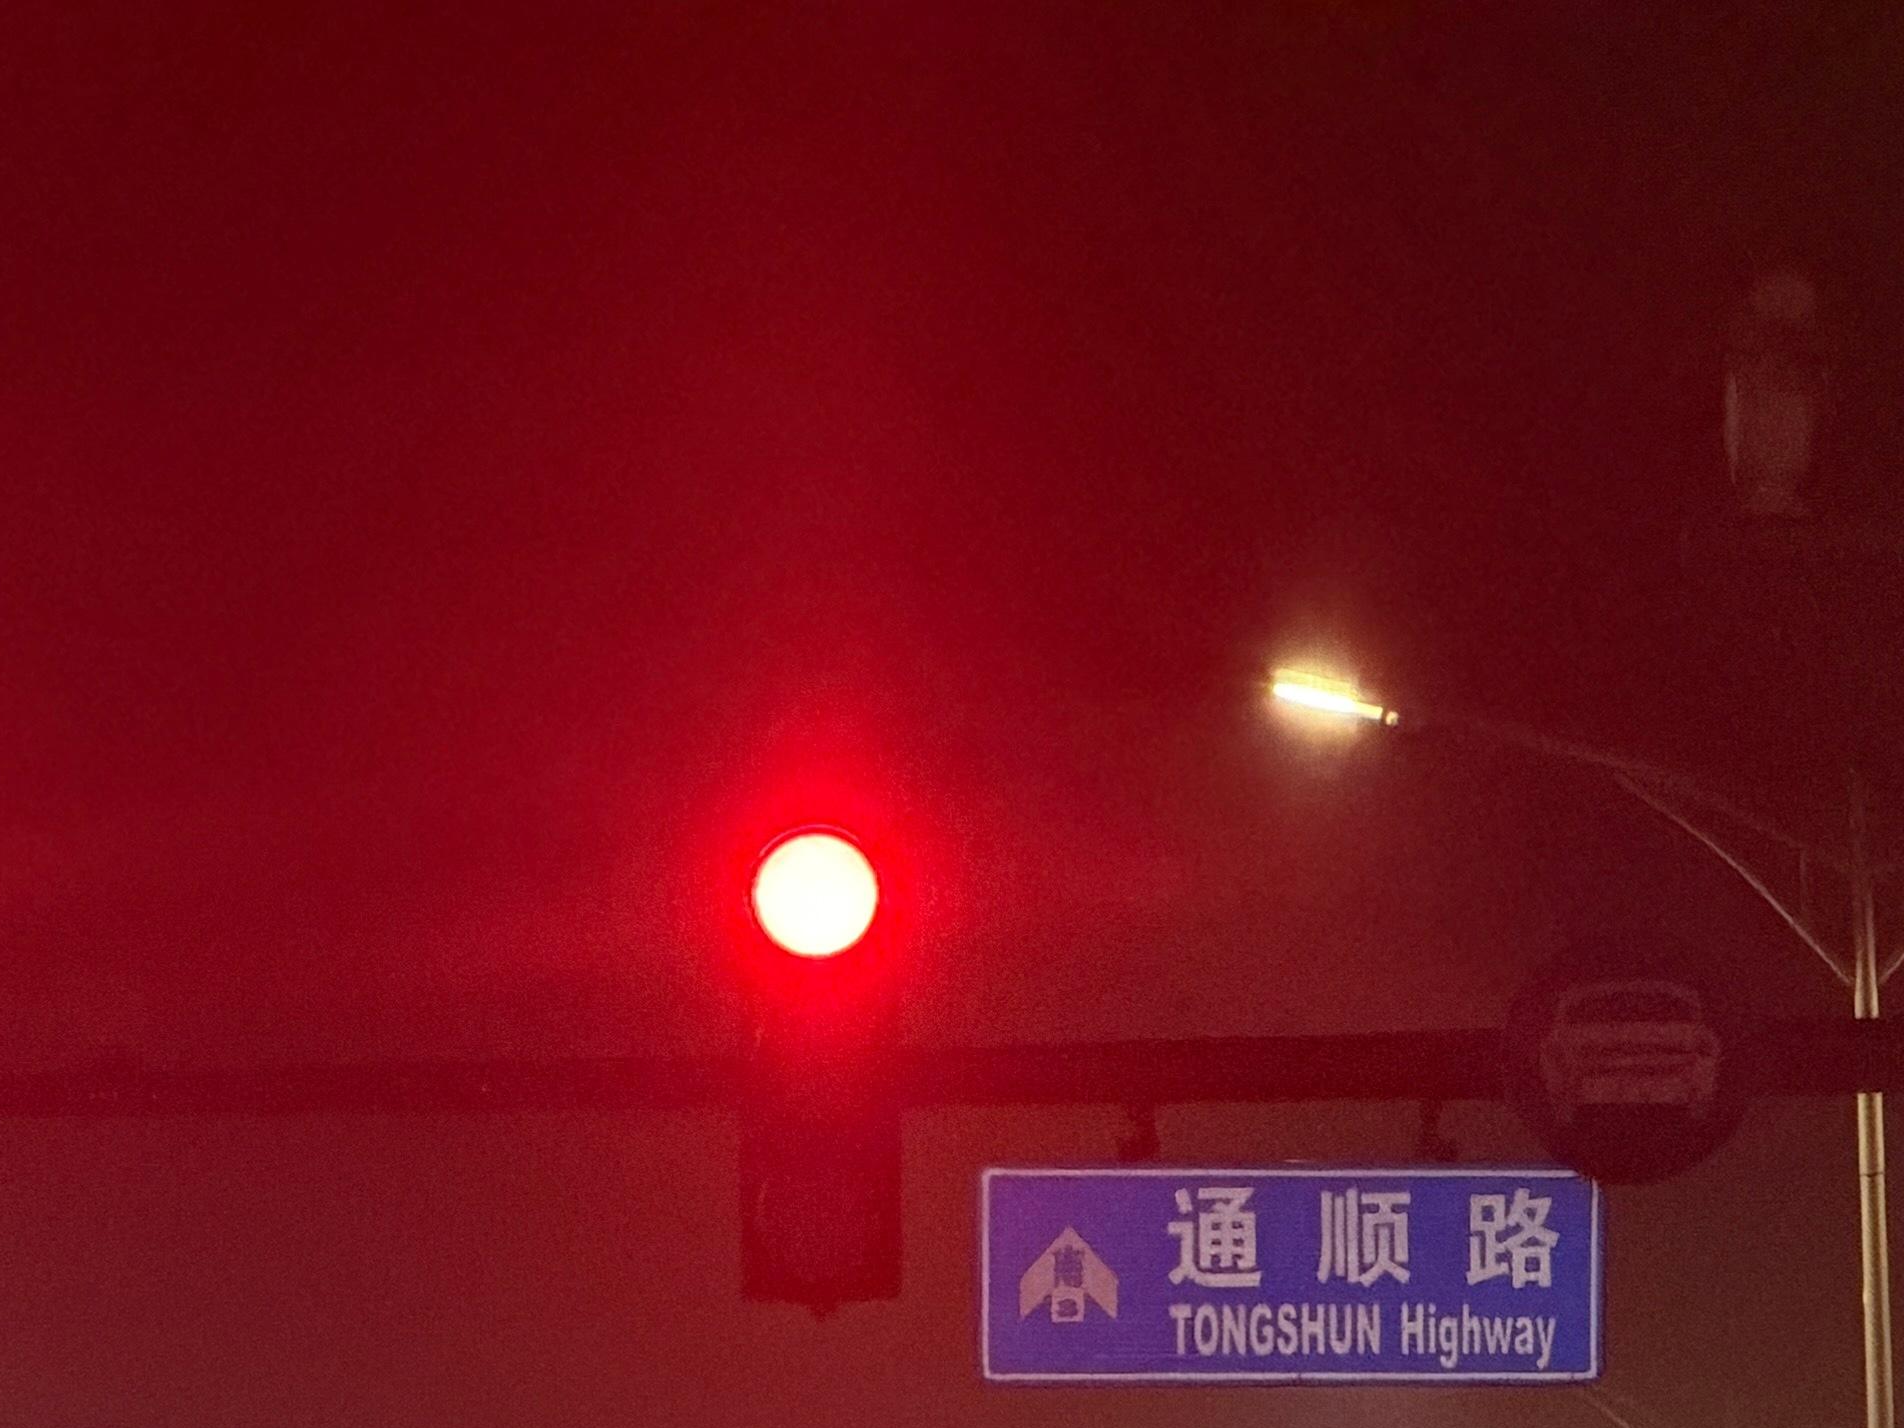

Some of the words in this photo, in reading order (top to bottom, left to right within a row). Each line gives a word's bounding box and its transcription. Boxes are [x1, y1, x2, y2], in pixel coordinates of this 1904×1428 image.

[1167, 1186, 1560, 1289] 通顺路
[1168, 1303, 1382, 1358] TONGSHUN
[1401, 1302, 1556, 1371] Highway
